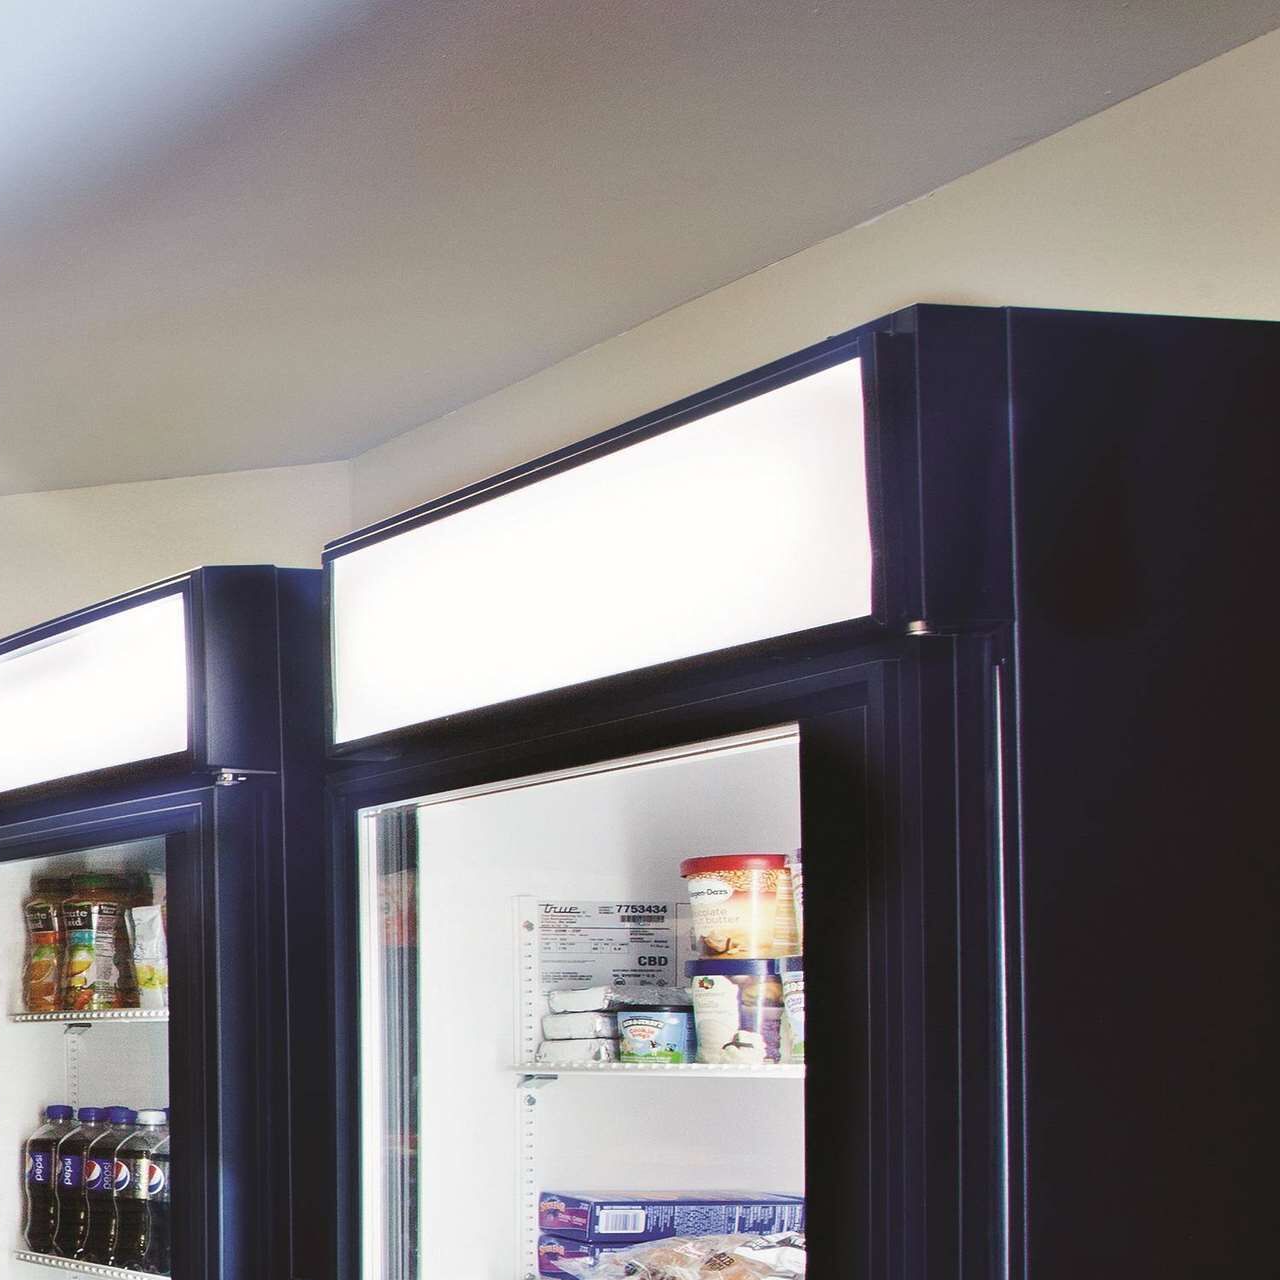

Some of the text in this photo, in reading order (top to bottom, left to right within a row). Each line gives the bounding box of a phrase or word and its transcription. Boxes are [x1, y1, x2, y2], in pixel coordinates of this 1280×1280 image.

[539, 904, 581, 914] true
[616, 904, 668, 914] 7753434
[638, 956, 669, 966] CBD
[35, 1154, 44, 1181] pepsi
[64, 1158, 73, 1186] pepsi
